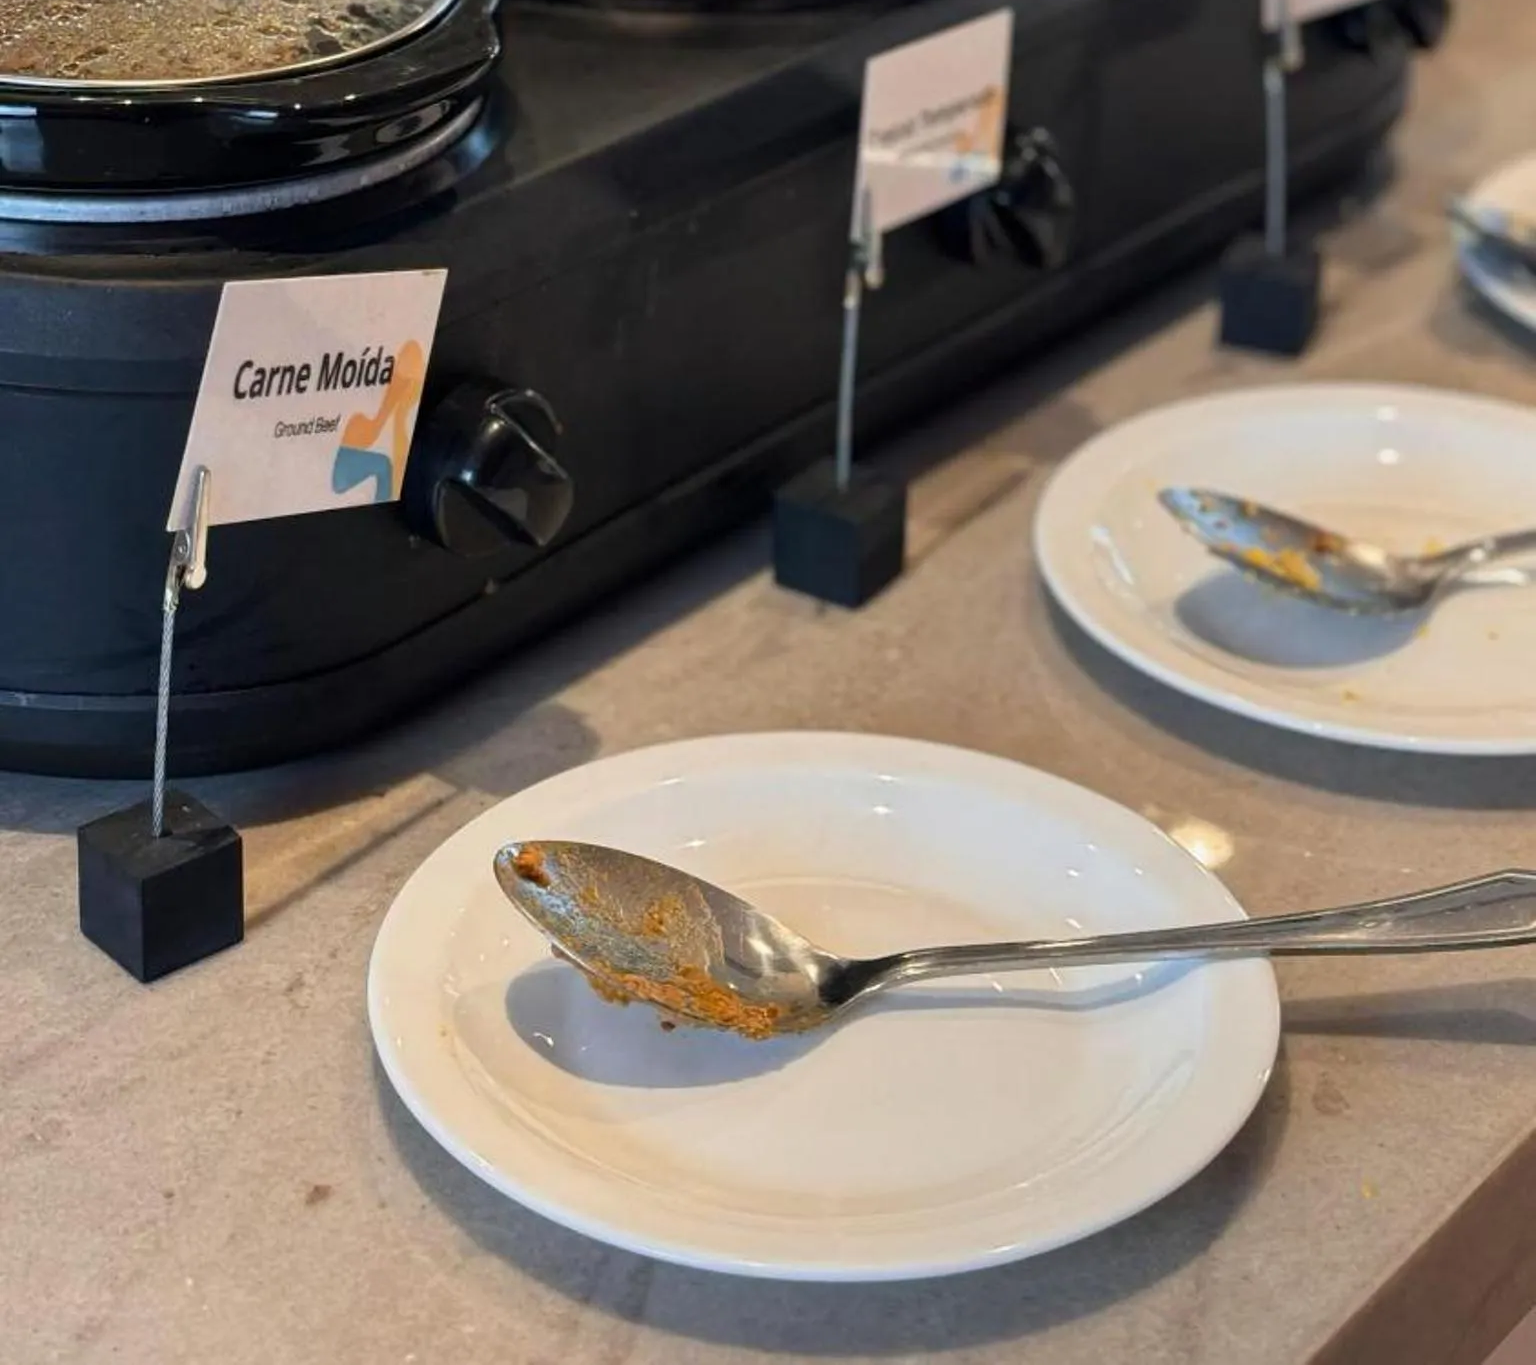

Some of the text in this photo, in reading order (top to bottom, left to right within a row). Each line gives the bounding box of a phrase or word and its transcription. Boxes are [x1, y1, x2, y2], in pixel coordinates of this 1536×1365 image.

[233, 346, 395, 400] Carne Moída
[274, 414, 341, 439] Ground Beef
